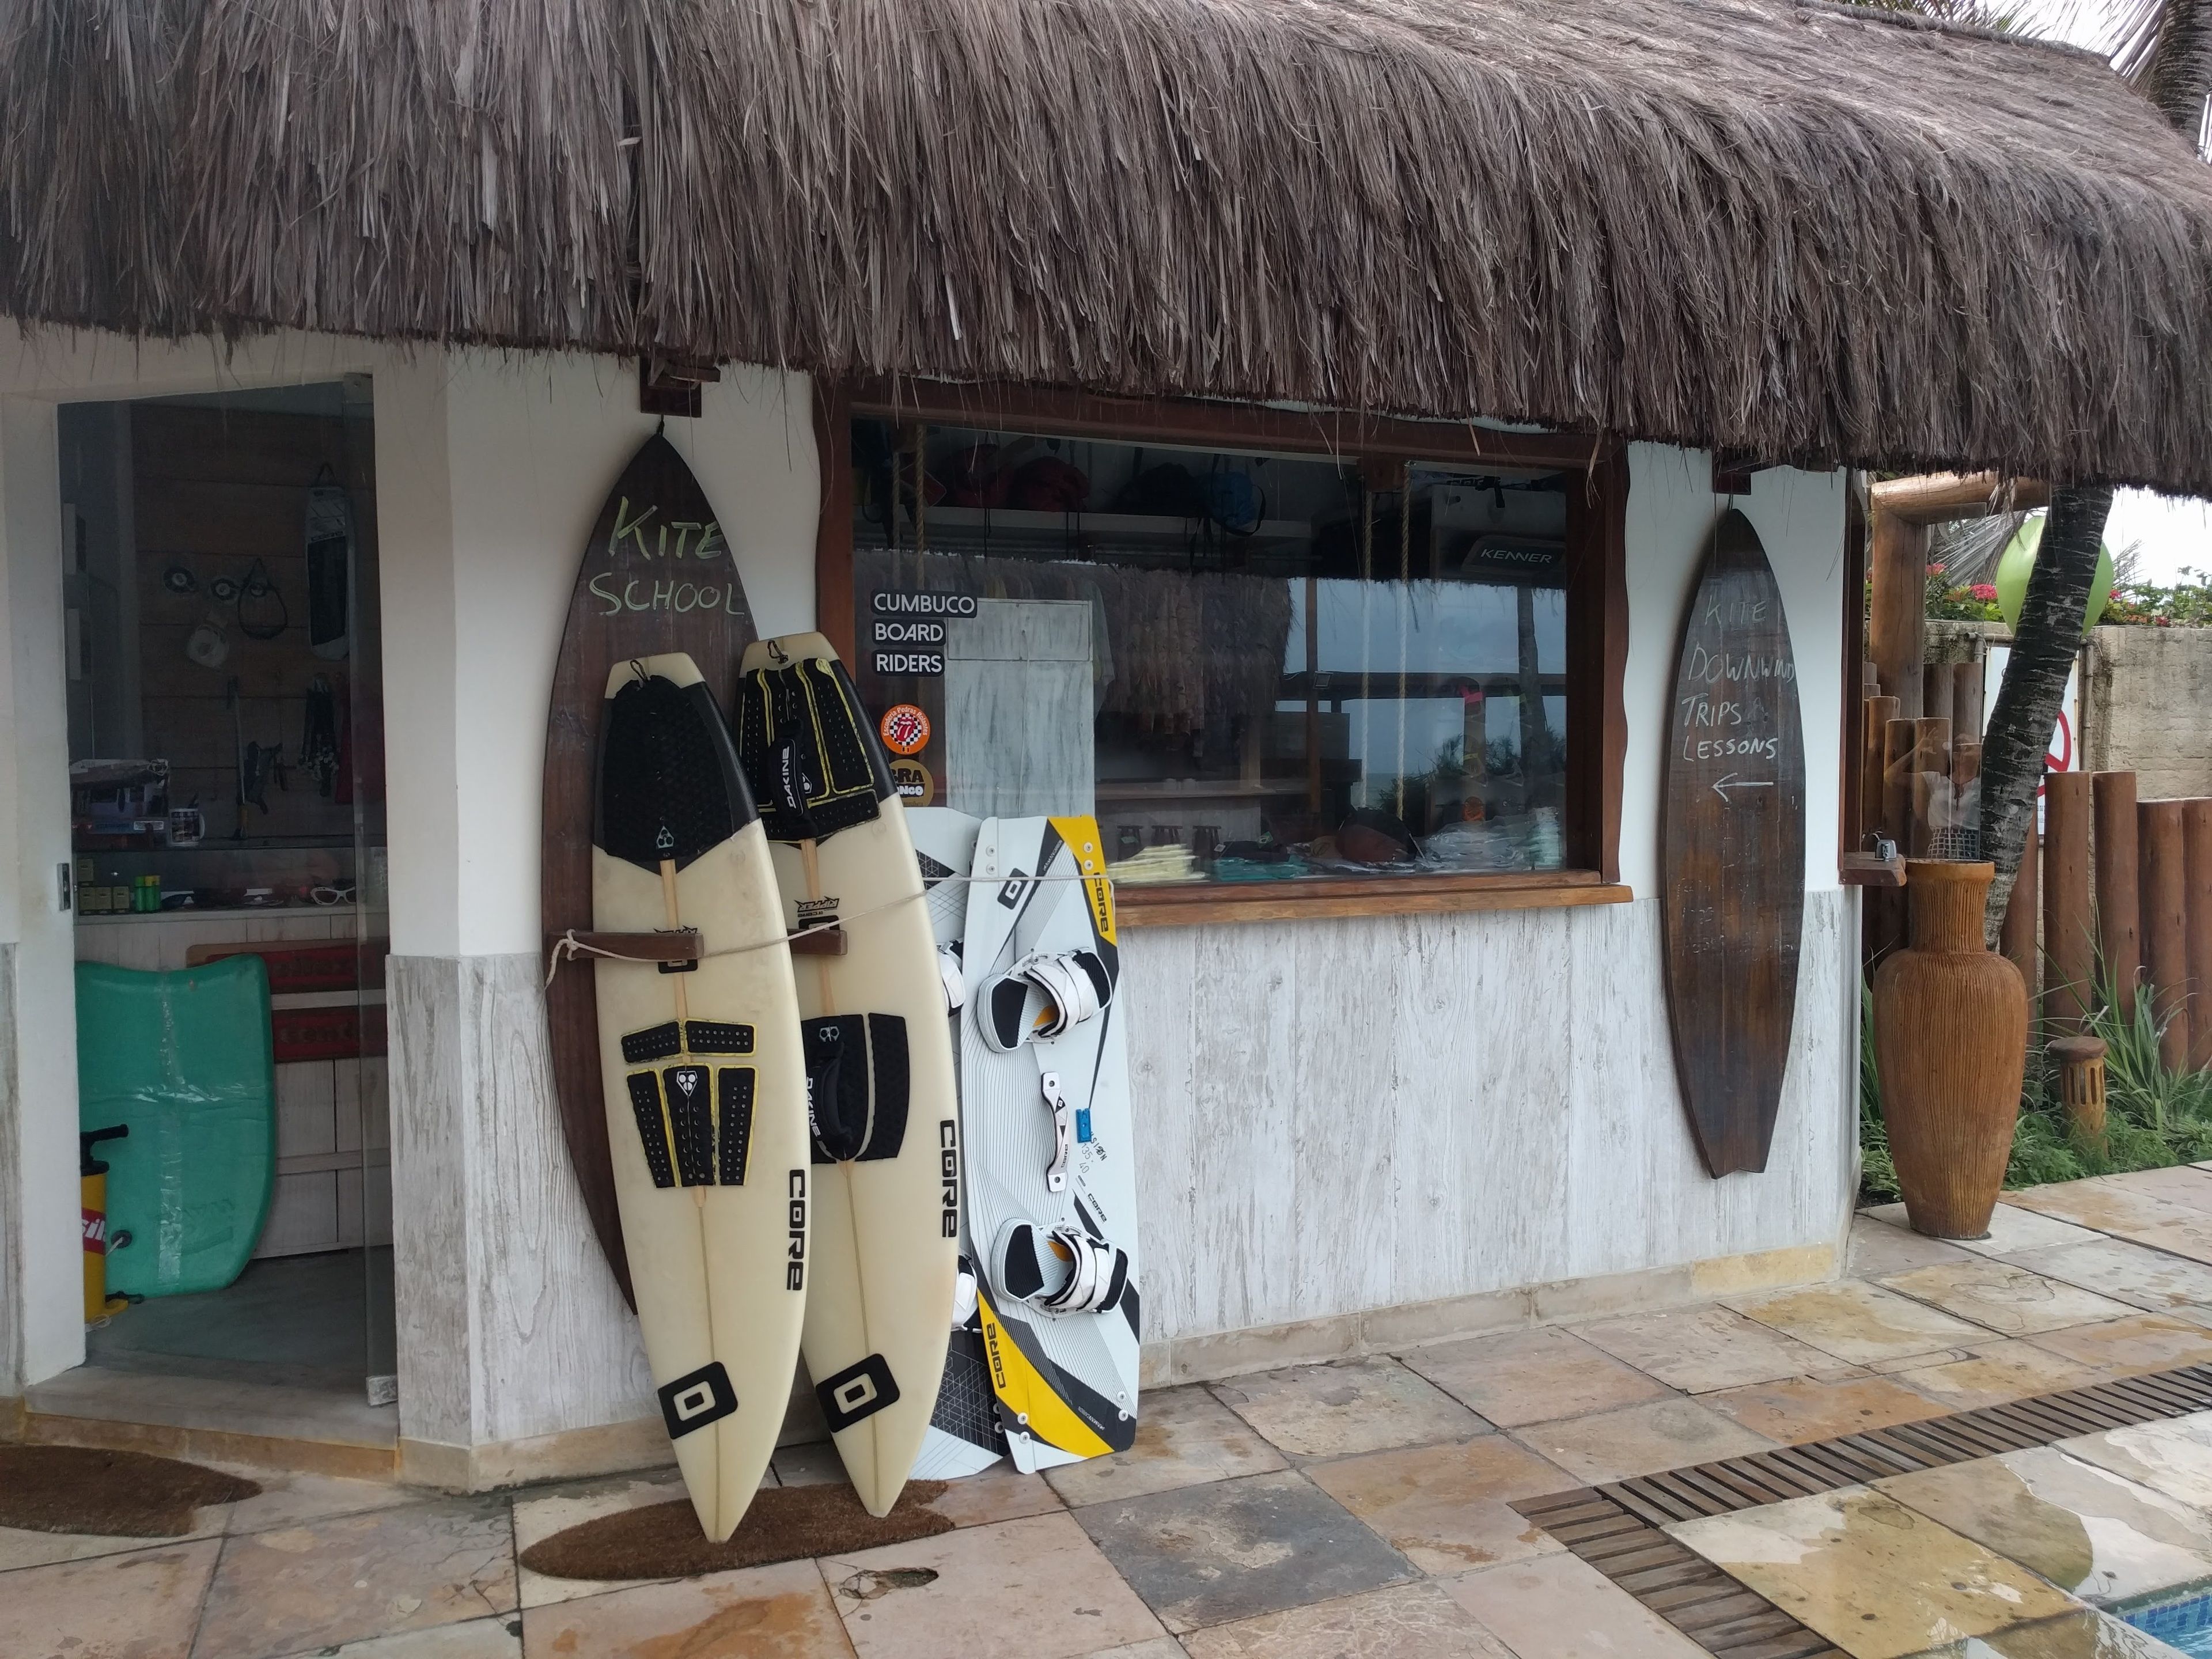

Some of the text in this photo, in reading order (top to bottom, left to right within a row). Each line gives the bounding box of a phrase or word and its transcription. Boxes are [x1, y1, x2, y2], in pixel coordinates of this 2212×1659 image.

[608, 496, 724, 560] KITE
[1480, 549, 1552, 563] KENNER
[589, 572, 744, 616] SCHOOL
[874, 593, 975, 614] CUMBUCO
[1705, 594, 1766, 629] KITE
[875, 623, 944, 642] BOARD
[876, 653, 942, 673] RIDERS
[1688, 642, 1796, 684] DOWNWIND
[897, 706, 916, 714] Pedras
[1681, 693, 1742, 727] TRIPS
[1683, 736, 1779, 762] LESSONS
[782, 746, 797, 809] DAKINE
[794, 895, 840, 912] RIPPER
[1093, 872, 1109, 933] CORE
[940, 1119, 957, 1238] CORE
[1079, 1162, 1090, 1174] 40
[1088, 1193, 1107, 1222] CORE
[787, 1169, 805, 1291] CORE
[986, 1322, 1006, 1389] CORE
